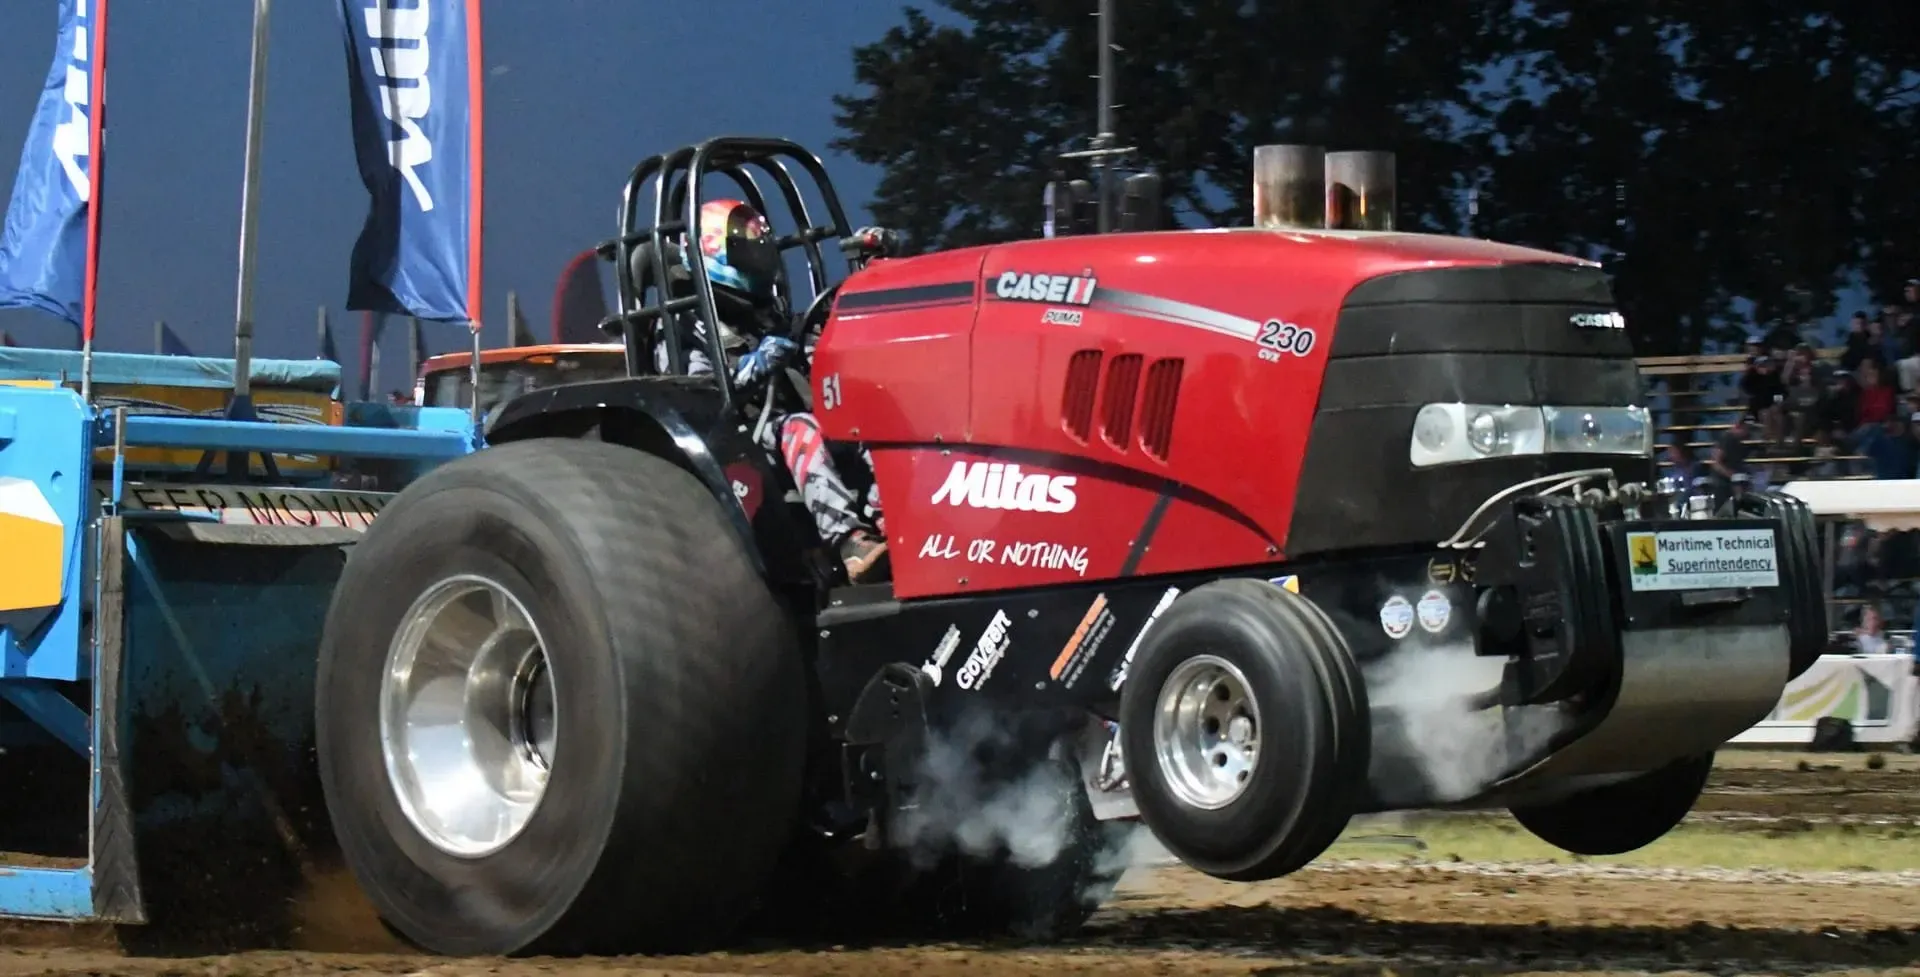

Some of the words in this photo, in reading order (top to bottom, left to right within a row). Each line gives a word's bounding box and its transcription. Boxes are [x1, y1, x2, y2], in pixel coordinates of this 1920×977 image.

[996, 271, 1069, 302] CASE
[1259, 319, 1315, 356] 230
[822, 372, 841, 410] 51
[931, 461, 1077, 513] Mitas
[918, 534, 960, 559] ALL
[967, 539, 996, 564] OR
[1000, 541, 1089, 577] NOTHING
[1658, 537, 1713, 551] Maritime
[1716, 534, 1775, 550] Technical
[1668, 556, 1772, 573] Superintendency
